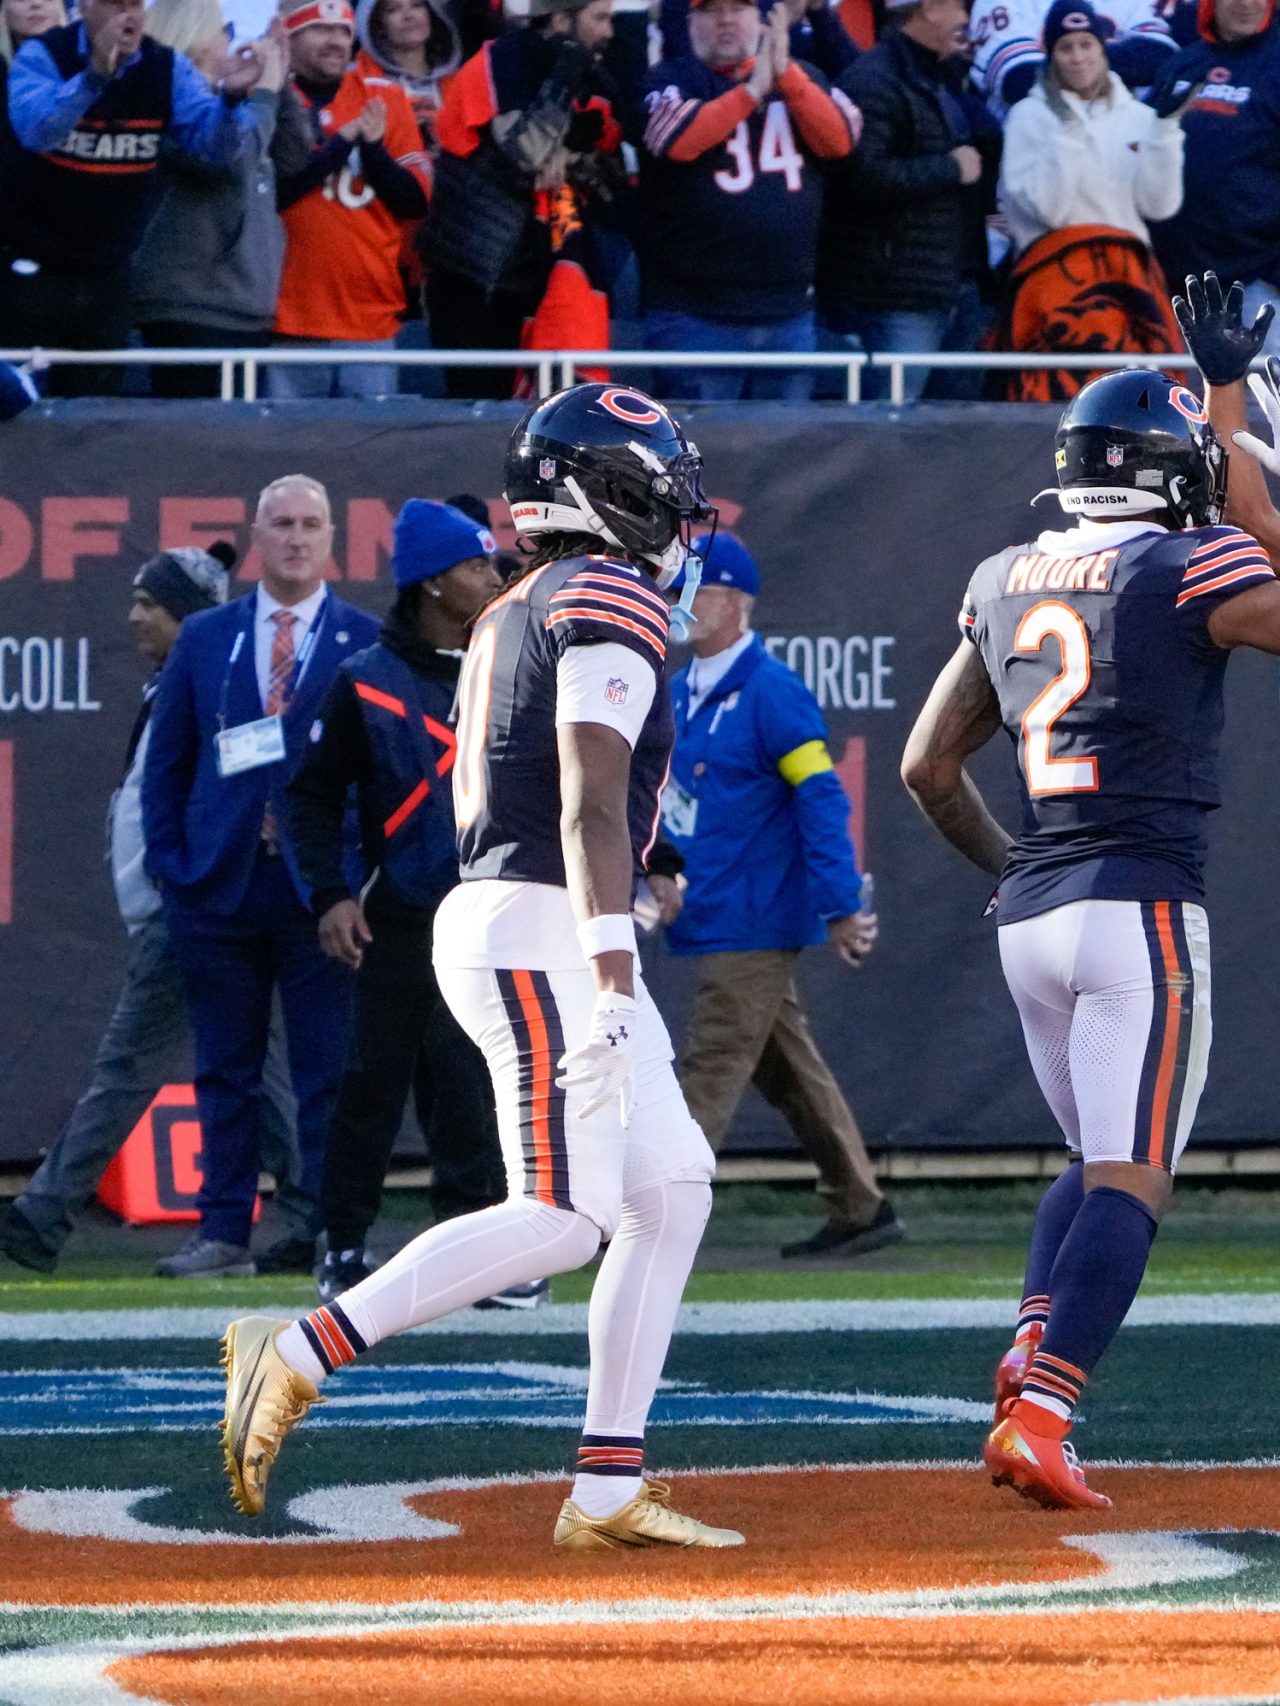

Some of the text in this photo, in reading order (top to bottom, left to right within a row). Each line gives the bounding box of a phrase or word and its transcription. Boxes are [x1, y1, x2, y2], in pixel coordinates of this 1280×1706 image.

[713, 100, 804, 194] 34
[1066, 495, 1128, 506] END RACISM
[1005, 548, 1120, 594] MOORE
[1014, 600, 1099, 796] 2
